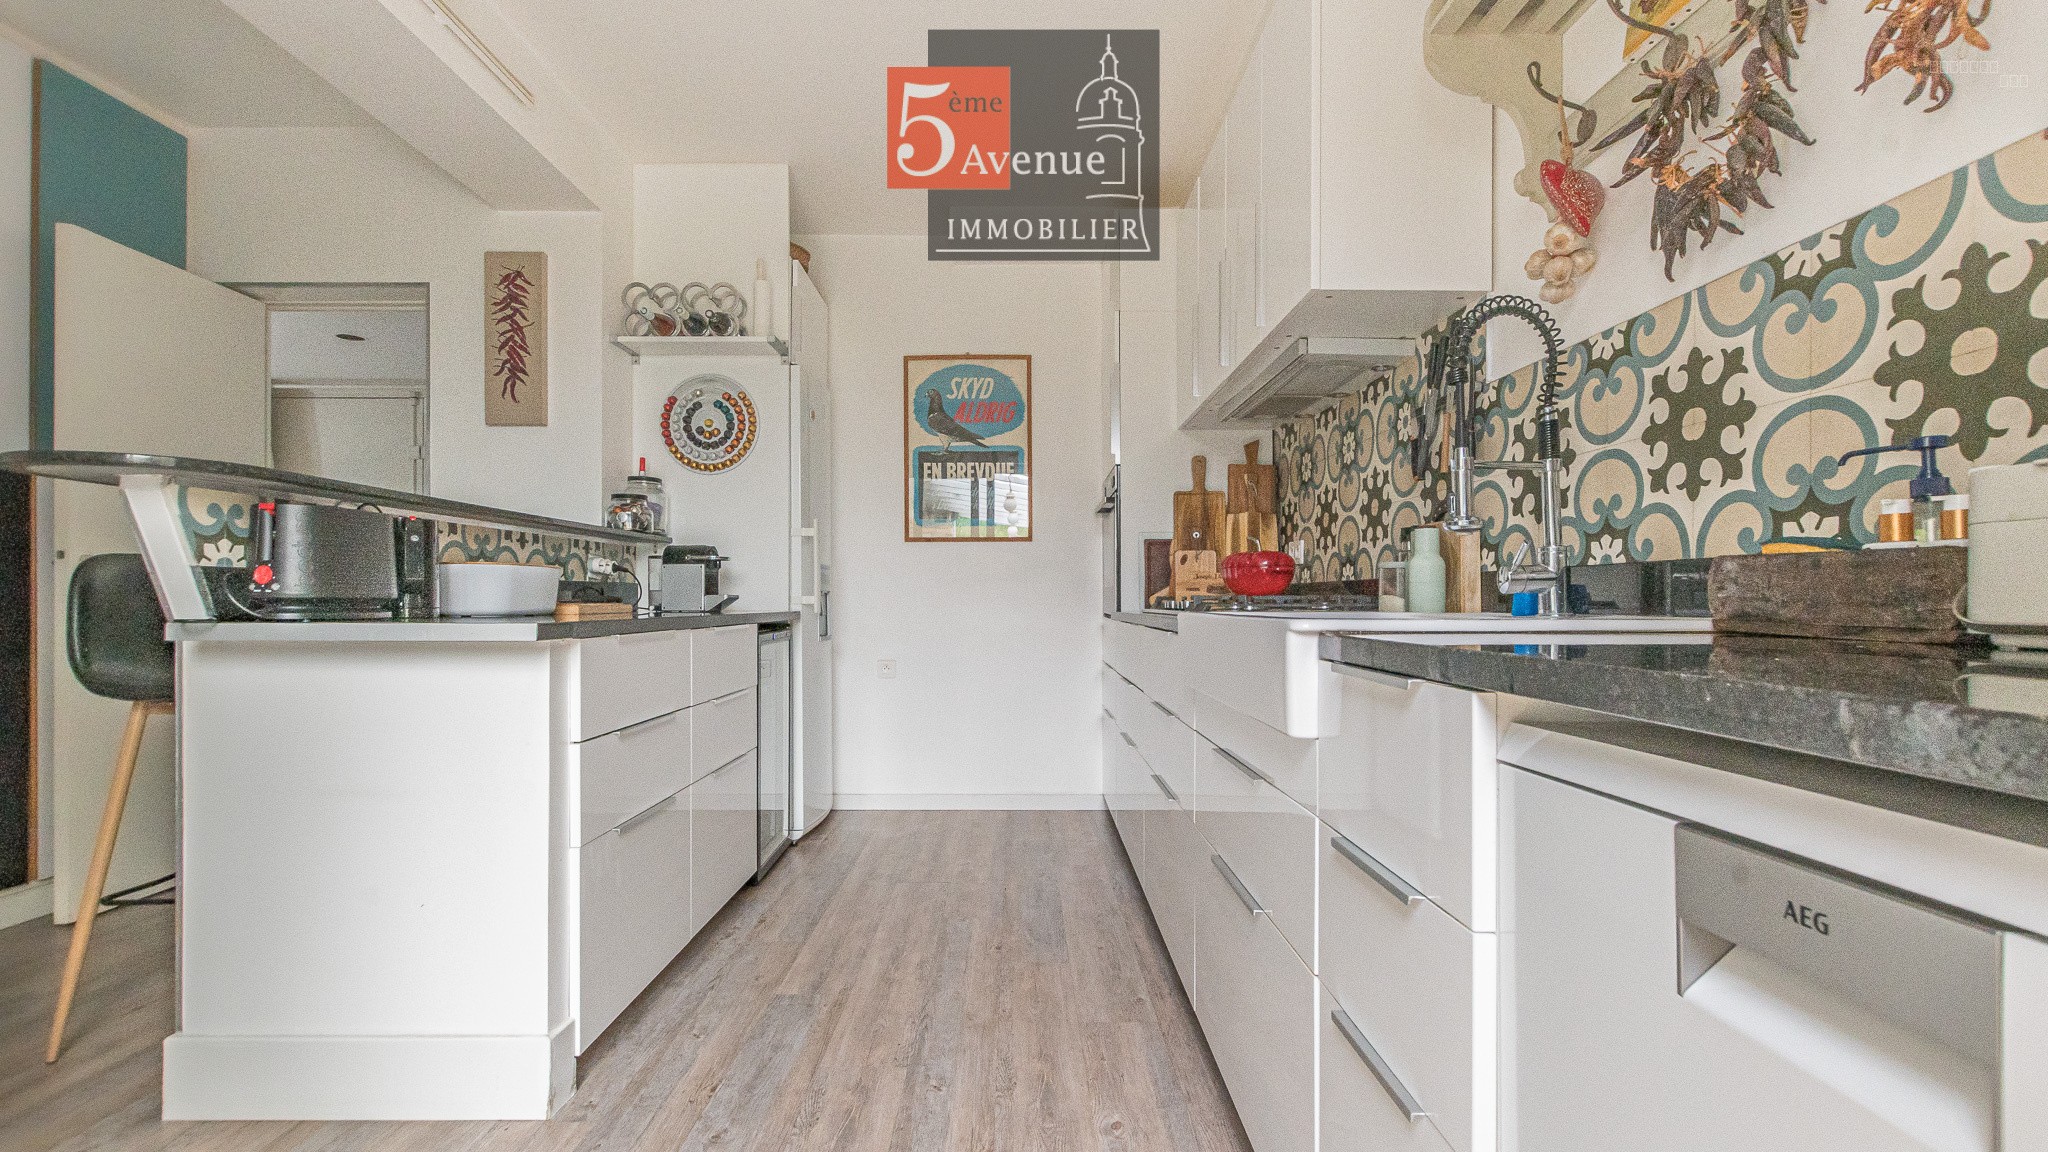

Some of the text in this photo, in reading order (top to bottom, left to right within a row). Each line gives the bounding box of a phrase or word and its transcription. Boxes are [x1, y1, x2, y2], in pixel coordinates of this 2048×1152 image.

[946, 377, 995, 399] SKYD
[953, 401, 1017, 424] ALDRIG
[923, 462, 942, 481] EN
[1783, 900, 1829, 935] AEG
